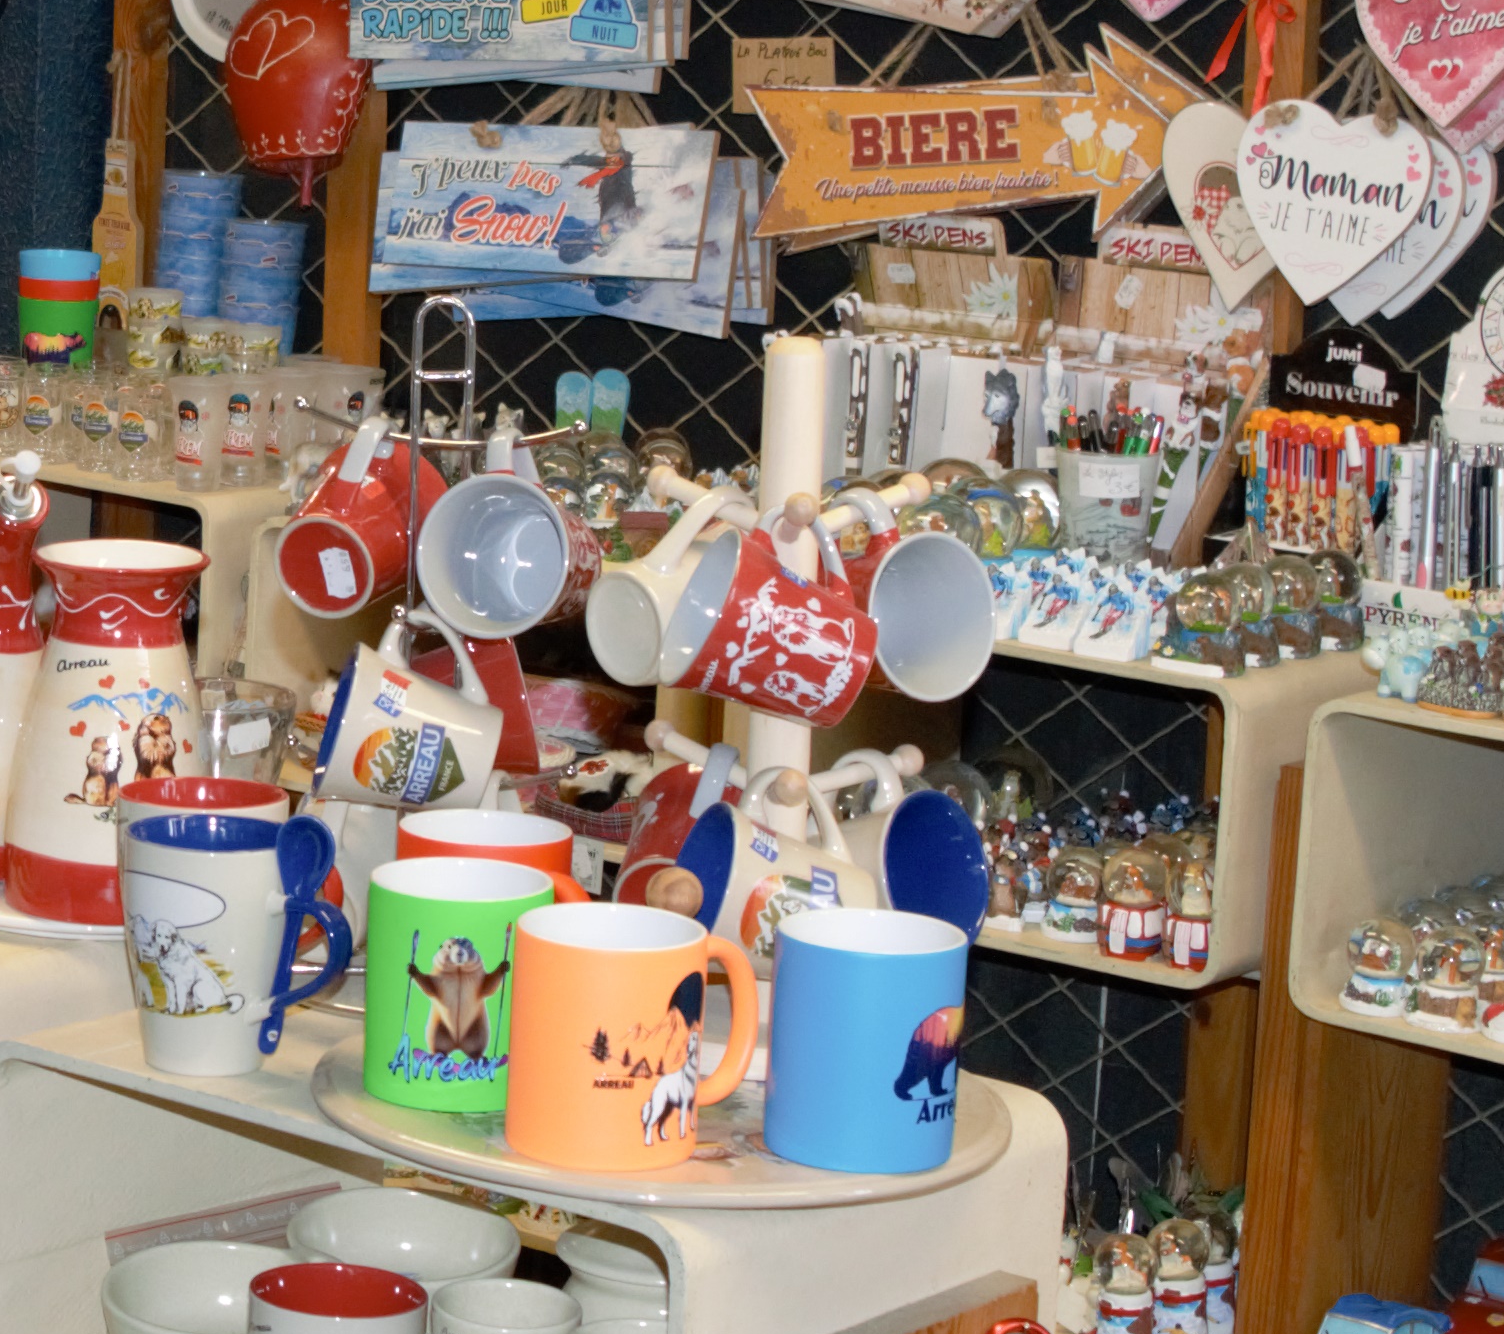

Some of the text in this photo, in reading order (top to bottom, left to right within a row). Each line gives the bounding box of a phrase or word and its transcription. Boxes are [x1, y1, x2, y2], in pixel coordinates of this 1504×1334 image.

[591, 26, 620, 44] NUIT
[737, 44, 750, 58] LA
[1393, 21, 1424, 61] je
[848, 107, 1021, 171] BIERE
[410, 154, 561, 200] J'peux pas
[1258, 152, 1413, 212] Maman
[395, 205, 447, 244] j'ai
[888, 223, 986, 247] SKI PENS
[1270, 203, 1369, 247] JE T'AIME
[1109, 236, 1153, 264] SKI
[1285, 372, 1401, 408] Souvenir
[55, 655, 111, 675] Arreau
[403, 725, 446, 806] ARREAU
[387, 1034, 509, 1083] Arreau
[592, 1078, 635, 1091] ARREAU
